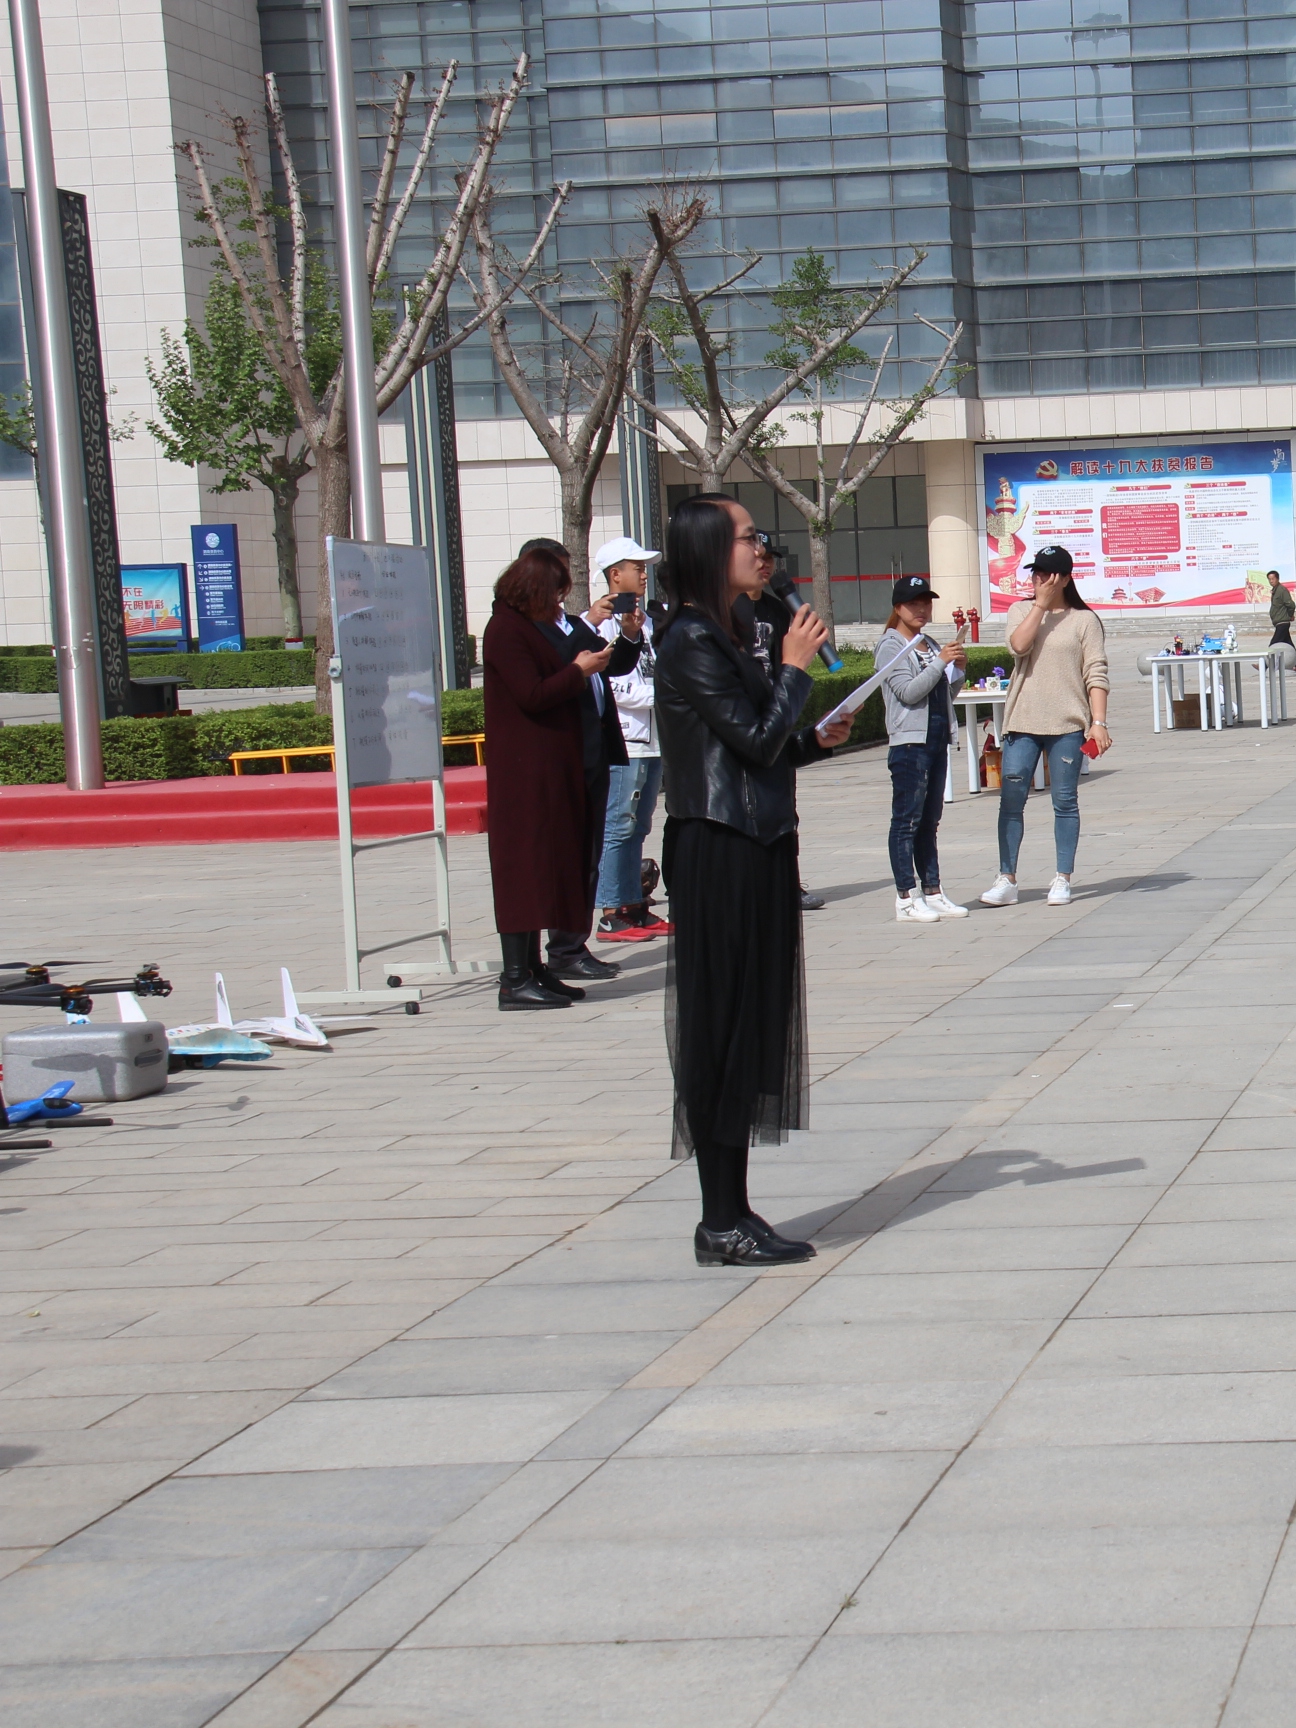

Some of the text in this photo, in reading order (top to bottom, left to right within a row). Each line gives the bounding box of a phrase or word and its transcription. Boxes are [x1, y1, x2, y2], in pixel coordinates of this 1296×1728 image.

[1069, 455, 1214, 476] 解读十九大扶贫报告
